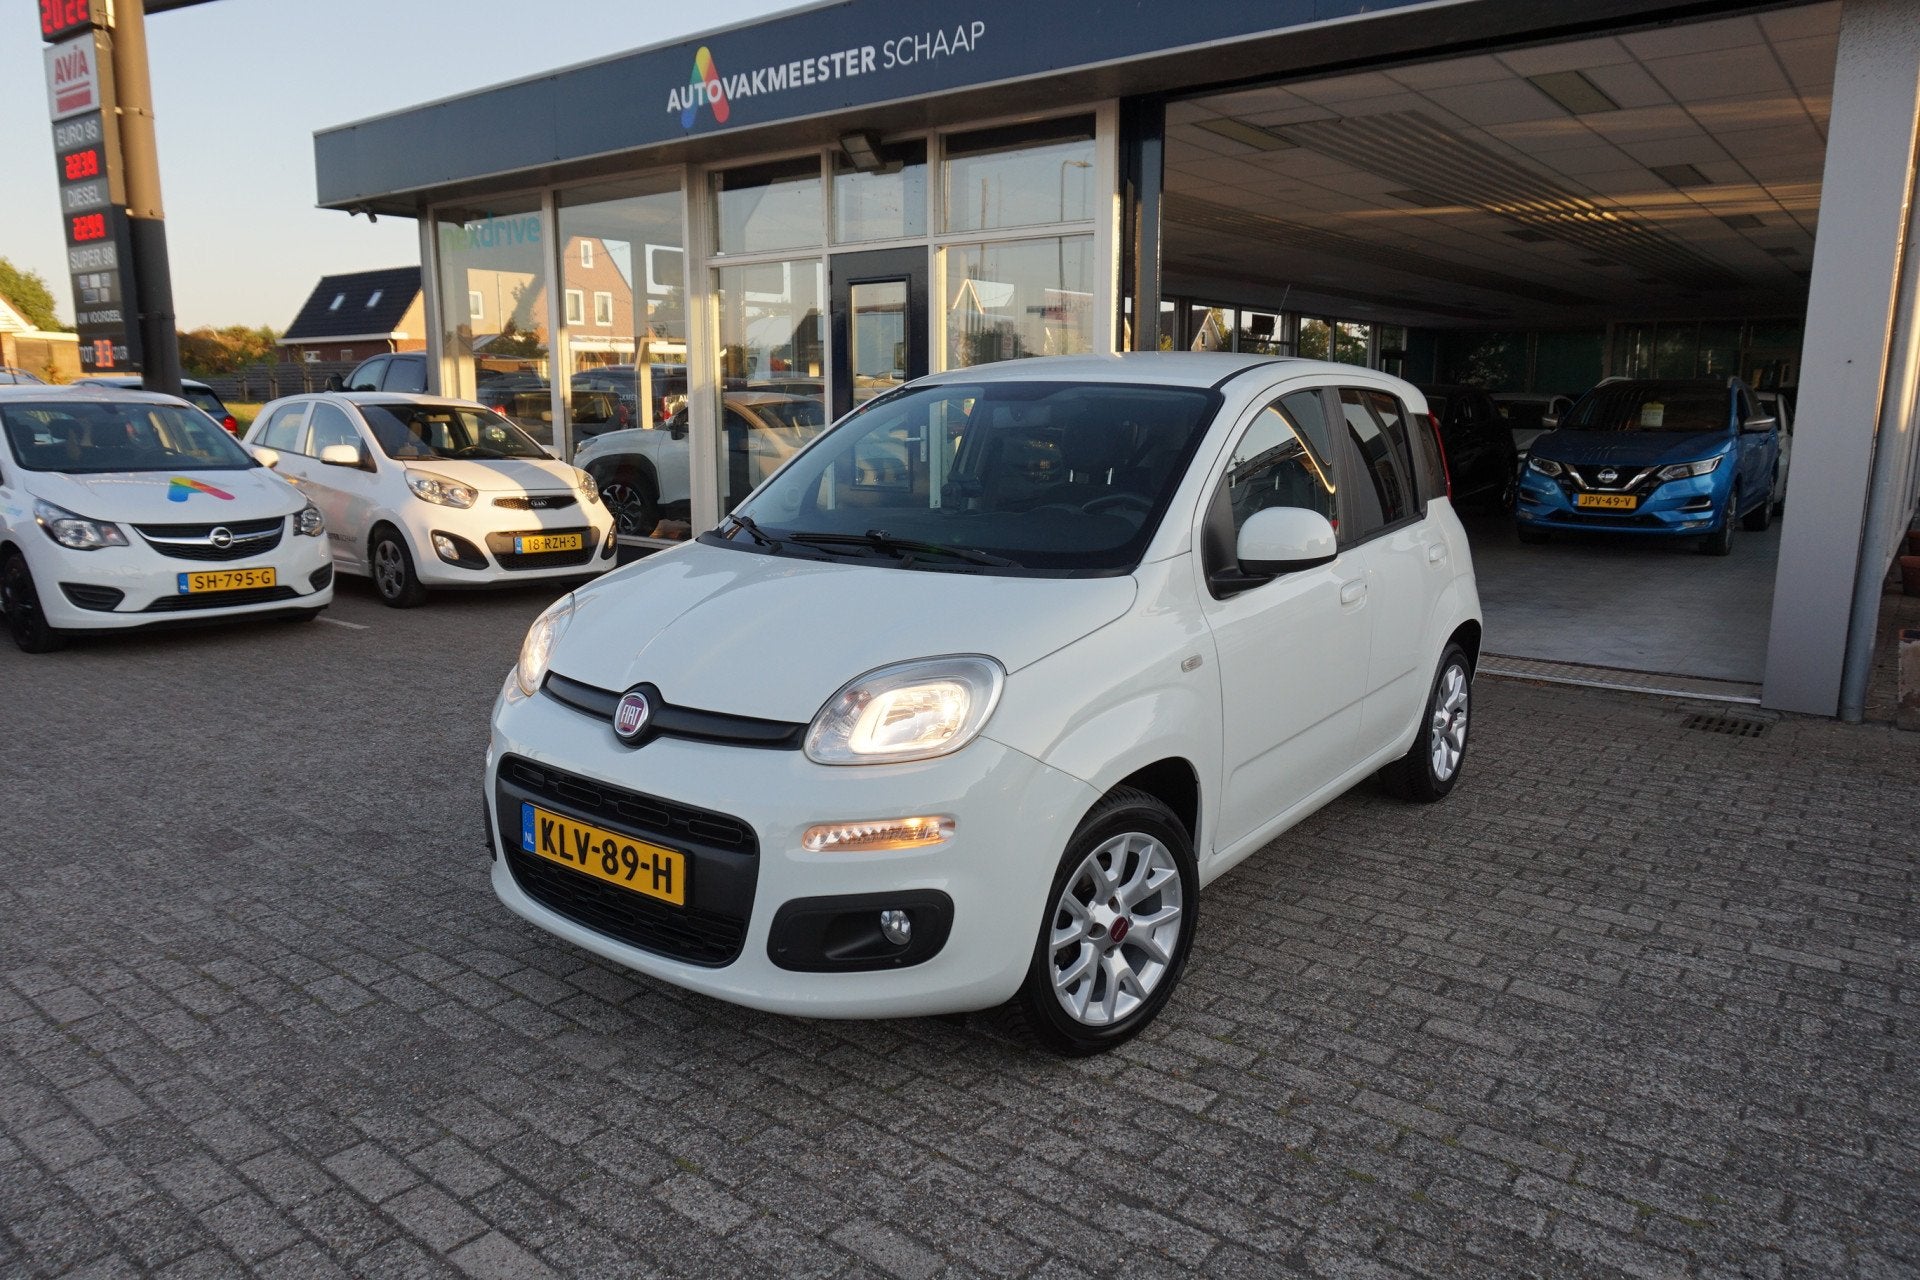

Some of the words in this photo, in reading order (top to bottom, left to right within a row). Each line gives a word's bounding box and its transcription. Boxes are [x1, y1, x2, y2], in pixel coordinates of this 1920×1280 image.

[55, 44, 90, 85] AVIA
[666, 45, 876, 112] AUTOVAKMEESTER
[882, 21, 986, 69] SCHAAP
[57, 123, 83, 147] EURO
[84, 119, 98, 140] 95
[67, 184, 102, 208] DIESEL
[70, 248, 101, 270] SUPER
[102, 246, 114, 265] 98
[89, 310, 123, 323] VOORDEEL
[1582, 495, 1631, 506] JPV-49-V
[528, 537, 577, 551] 18-RZH-3
[194, 571, 271, 589] SH-795-G
[620, 704, 642, 726] FIAT
[525, 831, 534, 844] NL
[541, 817, 672, 894] KLV-89-H
